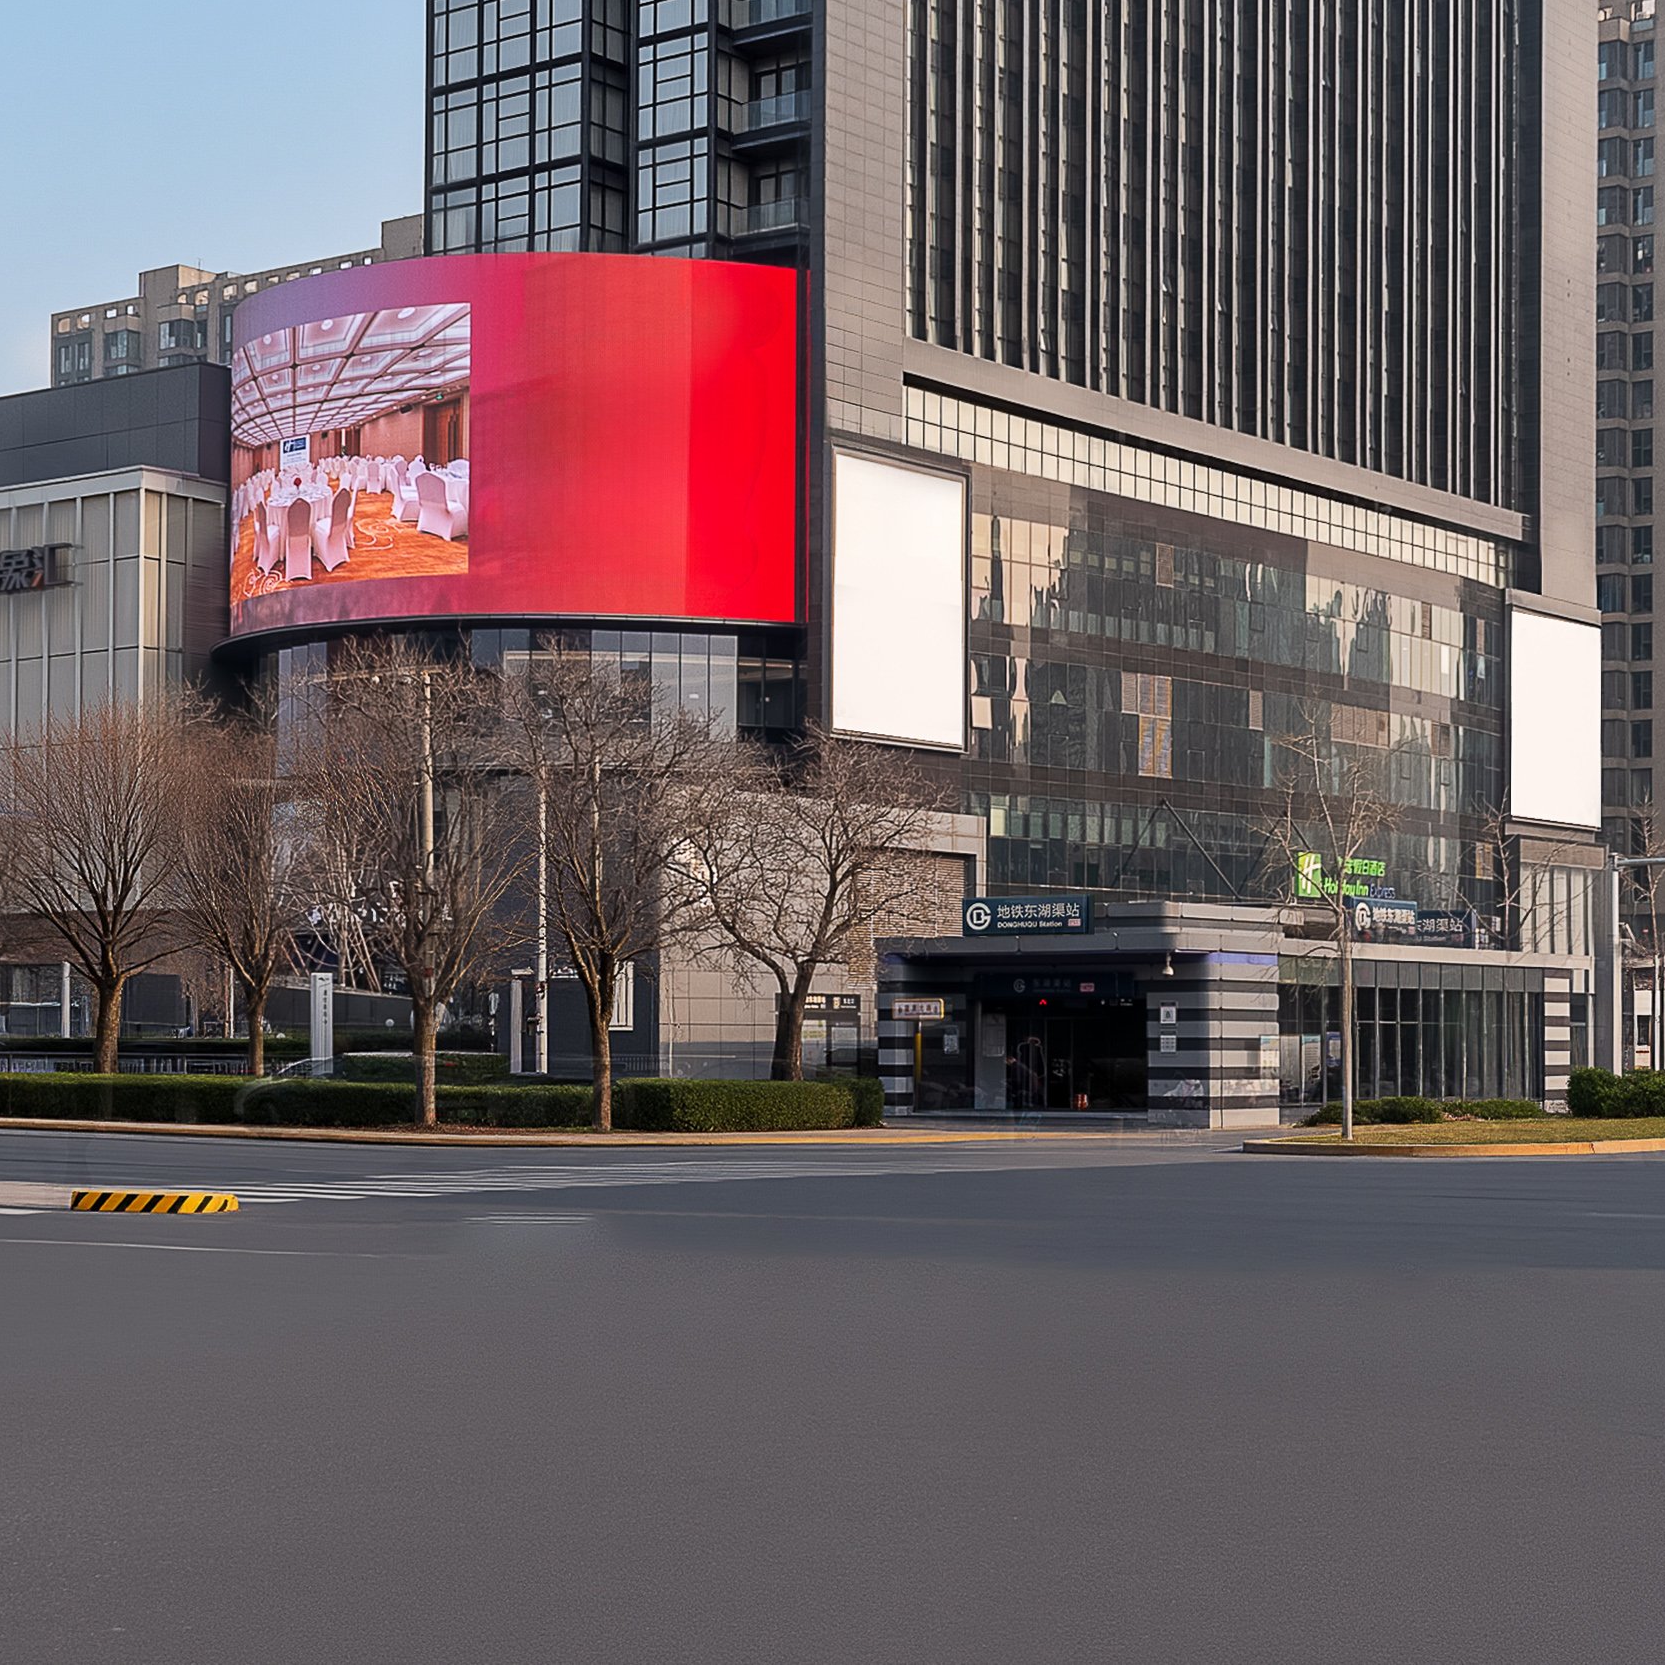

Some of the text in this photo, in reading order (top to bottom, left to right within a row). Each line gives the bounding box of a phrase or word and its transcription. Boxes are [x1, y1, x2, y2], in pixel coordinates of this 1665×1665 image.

[1324, 877, 1354, 897] Holday
[997, 902, 1080, 919] 地铁东湖渠站
